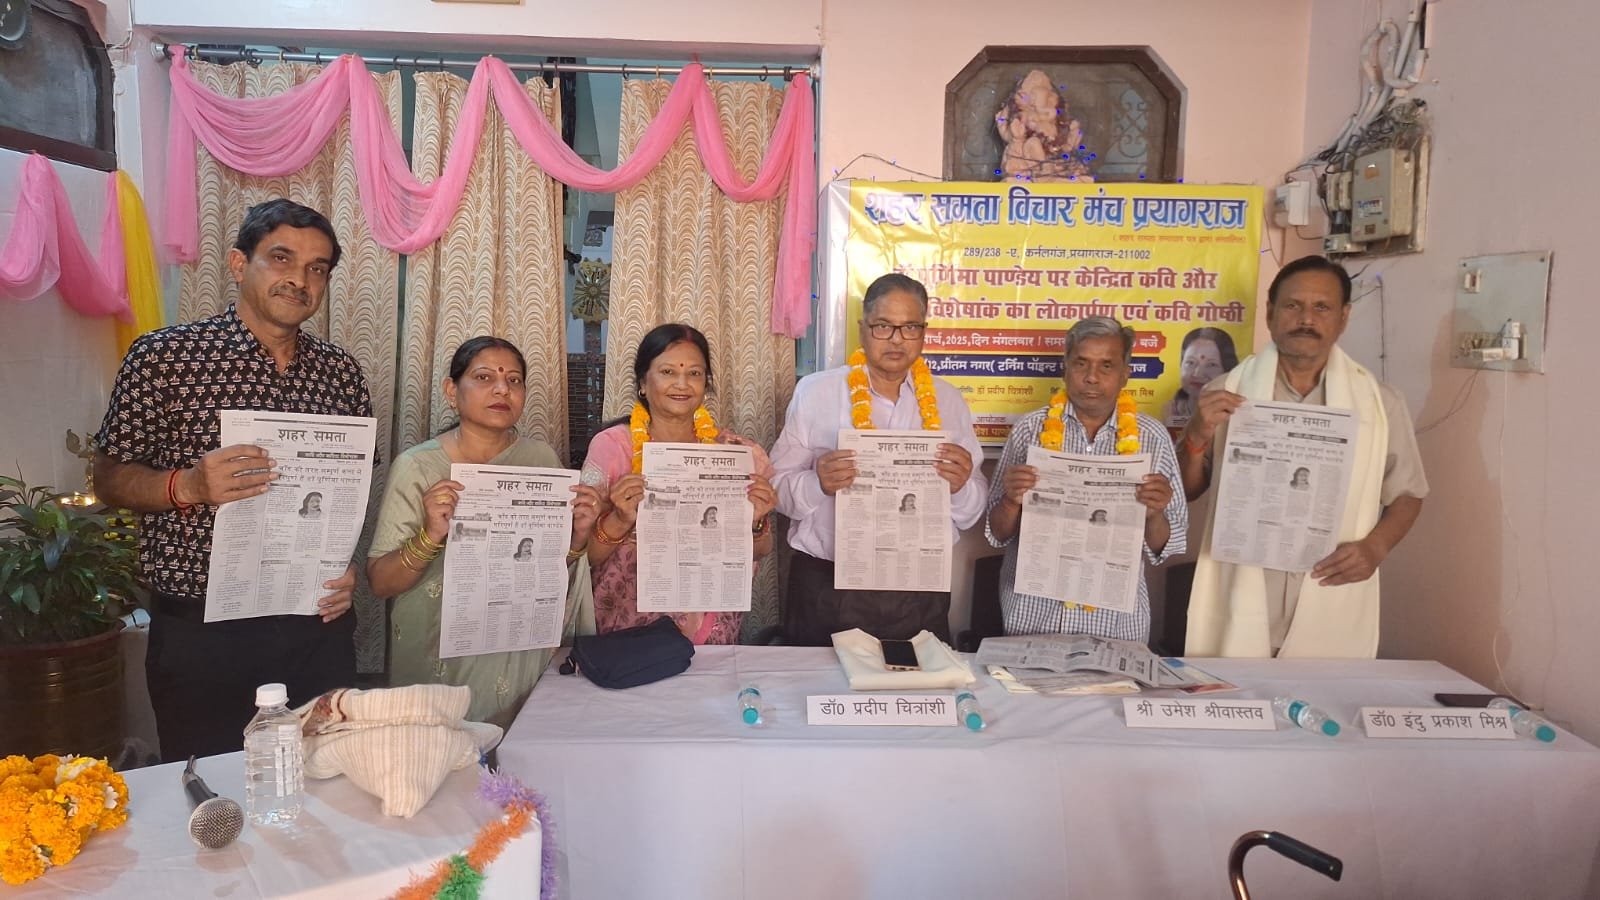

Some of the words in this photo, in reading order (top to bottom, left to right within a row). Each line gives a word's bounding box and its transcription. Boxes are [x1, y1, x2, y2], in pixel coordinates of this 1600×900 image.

[865, 193, 924, 224] शहर
[931, 194, 1001, 224] समता
[1008, 186, 1076, 225] विचार
[1084, 188, 1125, 225] मंच
[1133, 197, 1247, 229] प्रयागराज
[964, 247, 1001, 258] 289/238
[984, 265, 1043, 287] पाण्डेय
[1046, 269, 1071, 287] पर
[1075, 266, 1135, 288] केन्द्रित
[1138, 267, 1178, 289] कवि
[1183, 267, 1218, 289] और
[1005, 302, 1032, 319] का
[1121, 300, 1153, 321] एवं
[1154, 301, 1193, 321] कवि
[1196, 301, 1246, 323] गोष्ठी
[992, 333, 1034, 347] मंगलवार
[1272, 413, 1297, 424] शहर
[1302, 416, 1331, 428] समता
[278, 429, 307, 441] शहर
[313, 430, 347, 443] समता
[878, 442, 900, 452] शहर
[904, 442, 929, 452] समता
[683, 455, 706, 466] शहर
[711, 457, 736, 467] समता
[1068, 464, 1092, 474] शहर
[1097, 467, 1126, 476] समता
[496, 480, 521, 492] शहर
[525, 481, 552, 492] समता
[852, 698, 888, 715] प्रदीप
[895, 698, 946, 715] चित्रांशी
[1136, 700, 1153, 717] श्री
[1160, 702, 1196, 717] उमेश
[1204, 702, 1264, 720] श्रीवास्तव
[1402, 711, 1427, 732] इंदु
[1430, 714, 1472, 729] प्रकाश
[1479, 712, 1508, 729] मिश्र
